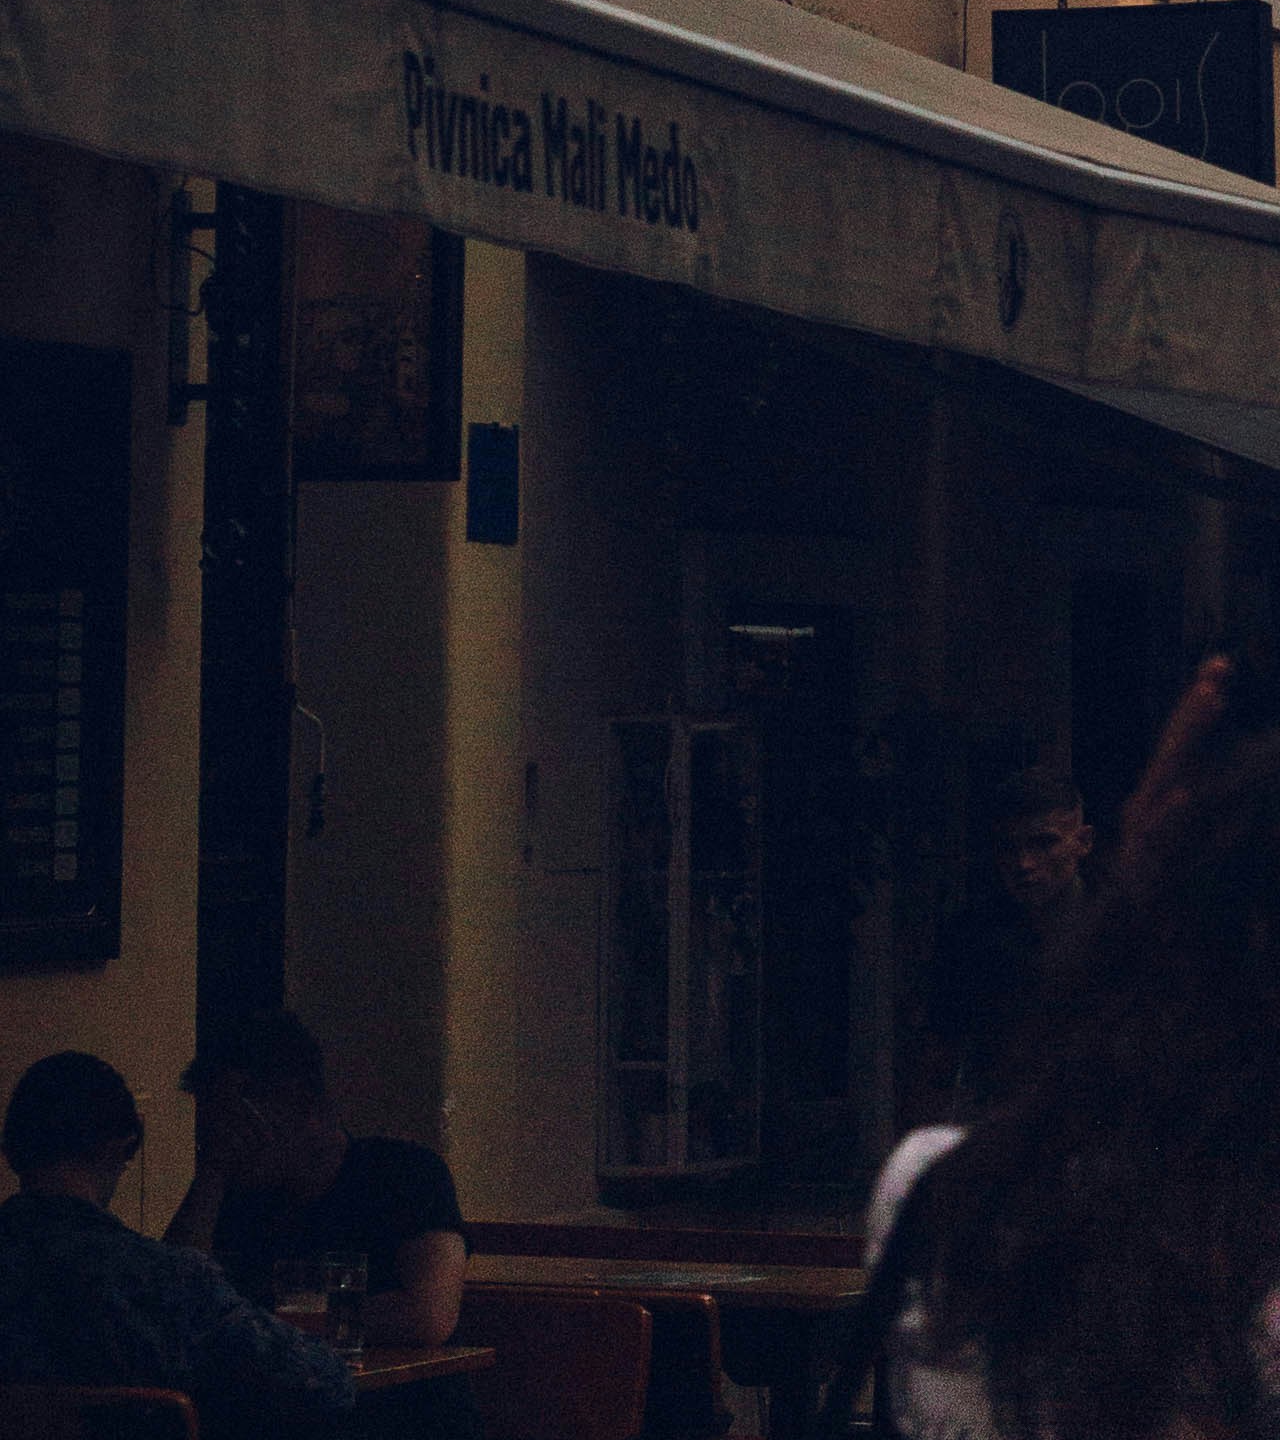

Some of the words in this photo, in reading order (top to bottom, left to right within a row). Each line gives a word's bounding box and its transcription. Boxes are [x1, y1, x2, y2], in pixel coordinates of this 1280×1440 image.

[403, 50, 533, 193] Pivnica
[541, 92, 606, 213] Mali
[615, 113, 699, 232] Medo
